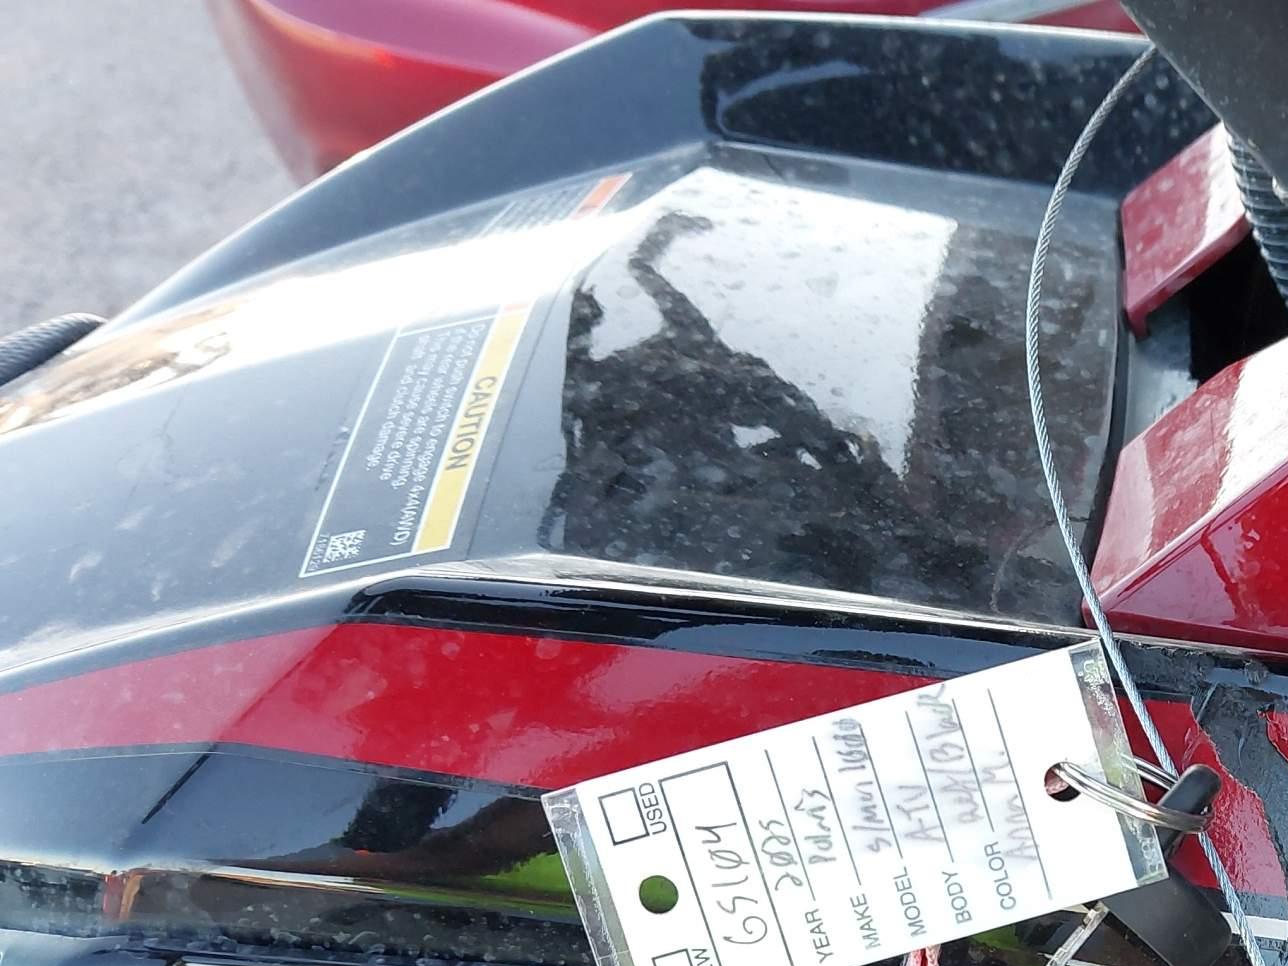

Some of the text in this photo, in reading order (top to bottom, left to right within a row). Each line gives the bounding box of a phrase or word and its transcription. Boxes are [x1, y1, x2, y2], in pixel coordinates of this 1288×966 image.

[437, 354, 453, 374] rear
[448, 358, 469, 385] push
[386, 385, 409, 419] clutch
[406, 377, 428, 409] cause
[420, 377, 444, 414] wheels
[433, 386, 458, 422] switch
[364, 420, 395, 471] damage.
[391, 411, 415, 449] severe
[412, 415, 430, 434] are
[429, 423, 445, 437] to
[446, 375, 497, 471] CAUTION
[379, 450, 401, 480] drive
[391, 436, 422, 490] spinning.
[410, 438, 438, 482] engage
[389, 484, 425, 546] 4x4(AWD)
[638, 781, 667, 834] USED
[758, 819, 803, 892] 2025
[984, 840, 1016, 911] COLOR
[892, 866, 925, 937] MODEL
[941, 867, 972, 924] BODY
[804, 908, 833, 963] YEAR
[850, 893, 880, 949] MAKE
